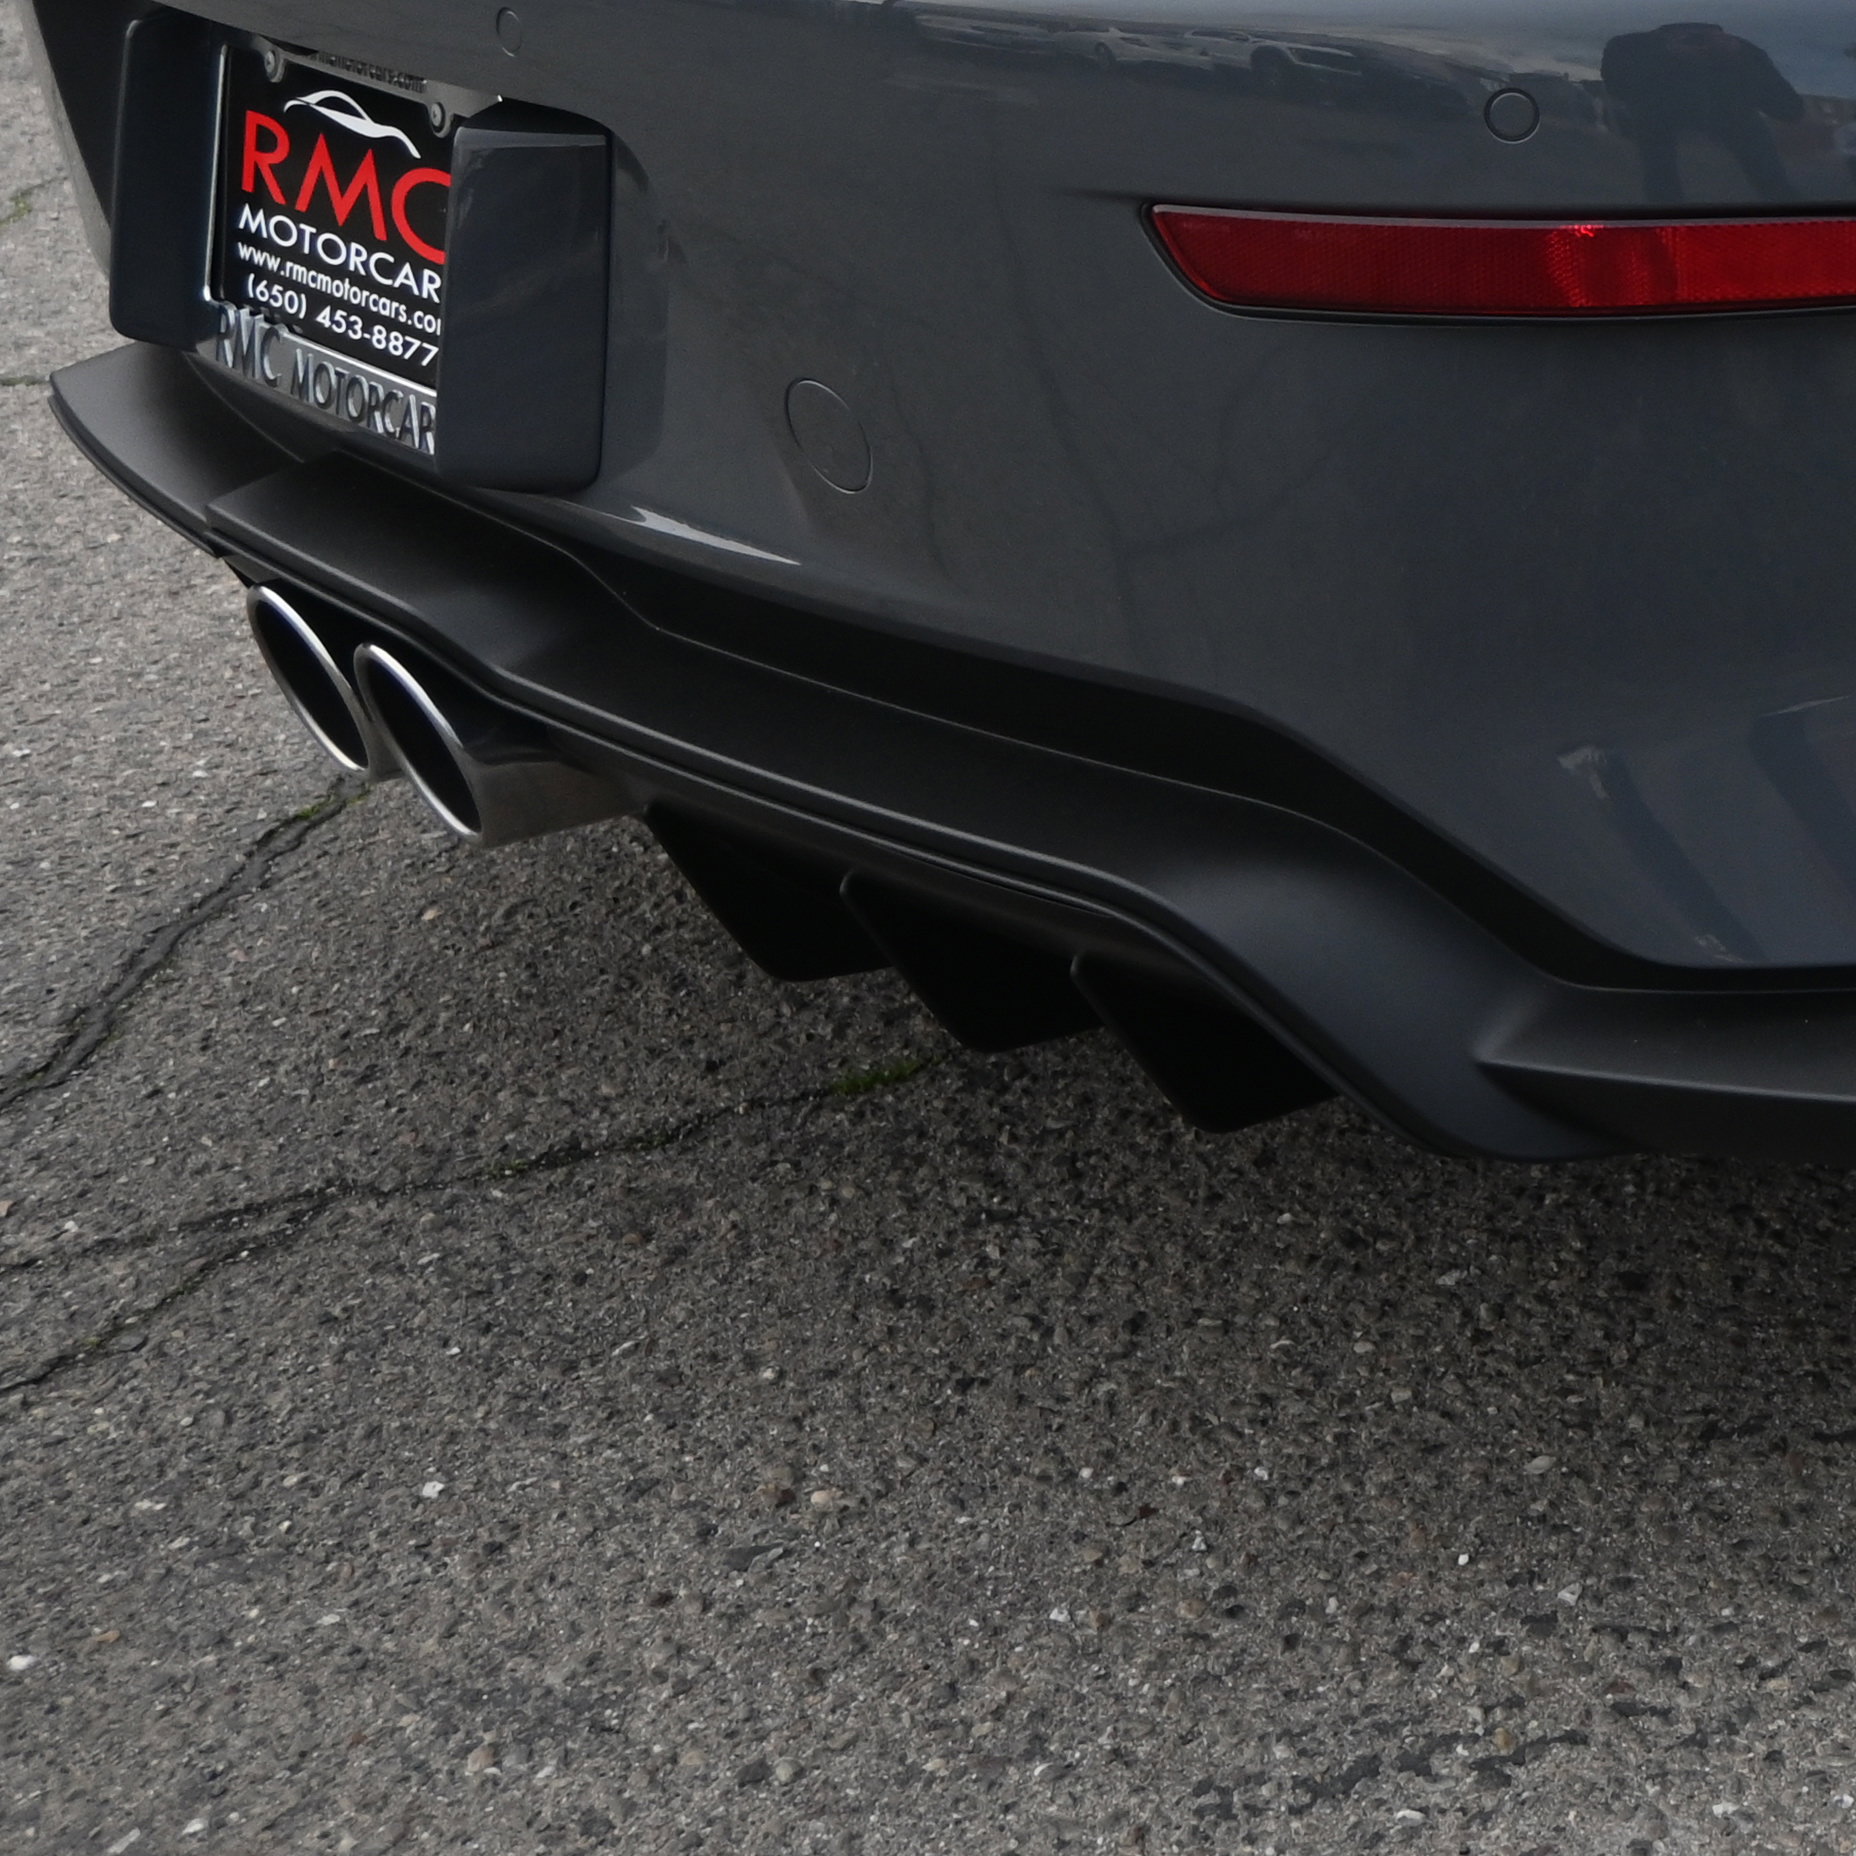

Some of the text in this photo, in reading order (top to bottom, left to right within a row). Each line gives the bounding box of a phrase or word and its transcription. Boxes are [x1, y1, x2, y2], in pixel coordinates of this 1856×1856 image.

[242, 109, 452, 265] RMC
[238, 202, 442, 303] MOTORCAR
[216, 300, 282, 387] RMC
[248, 273, 439, 367] (650) 453-8877
